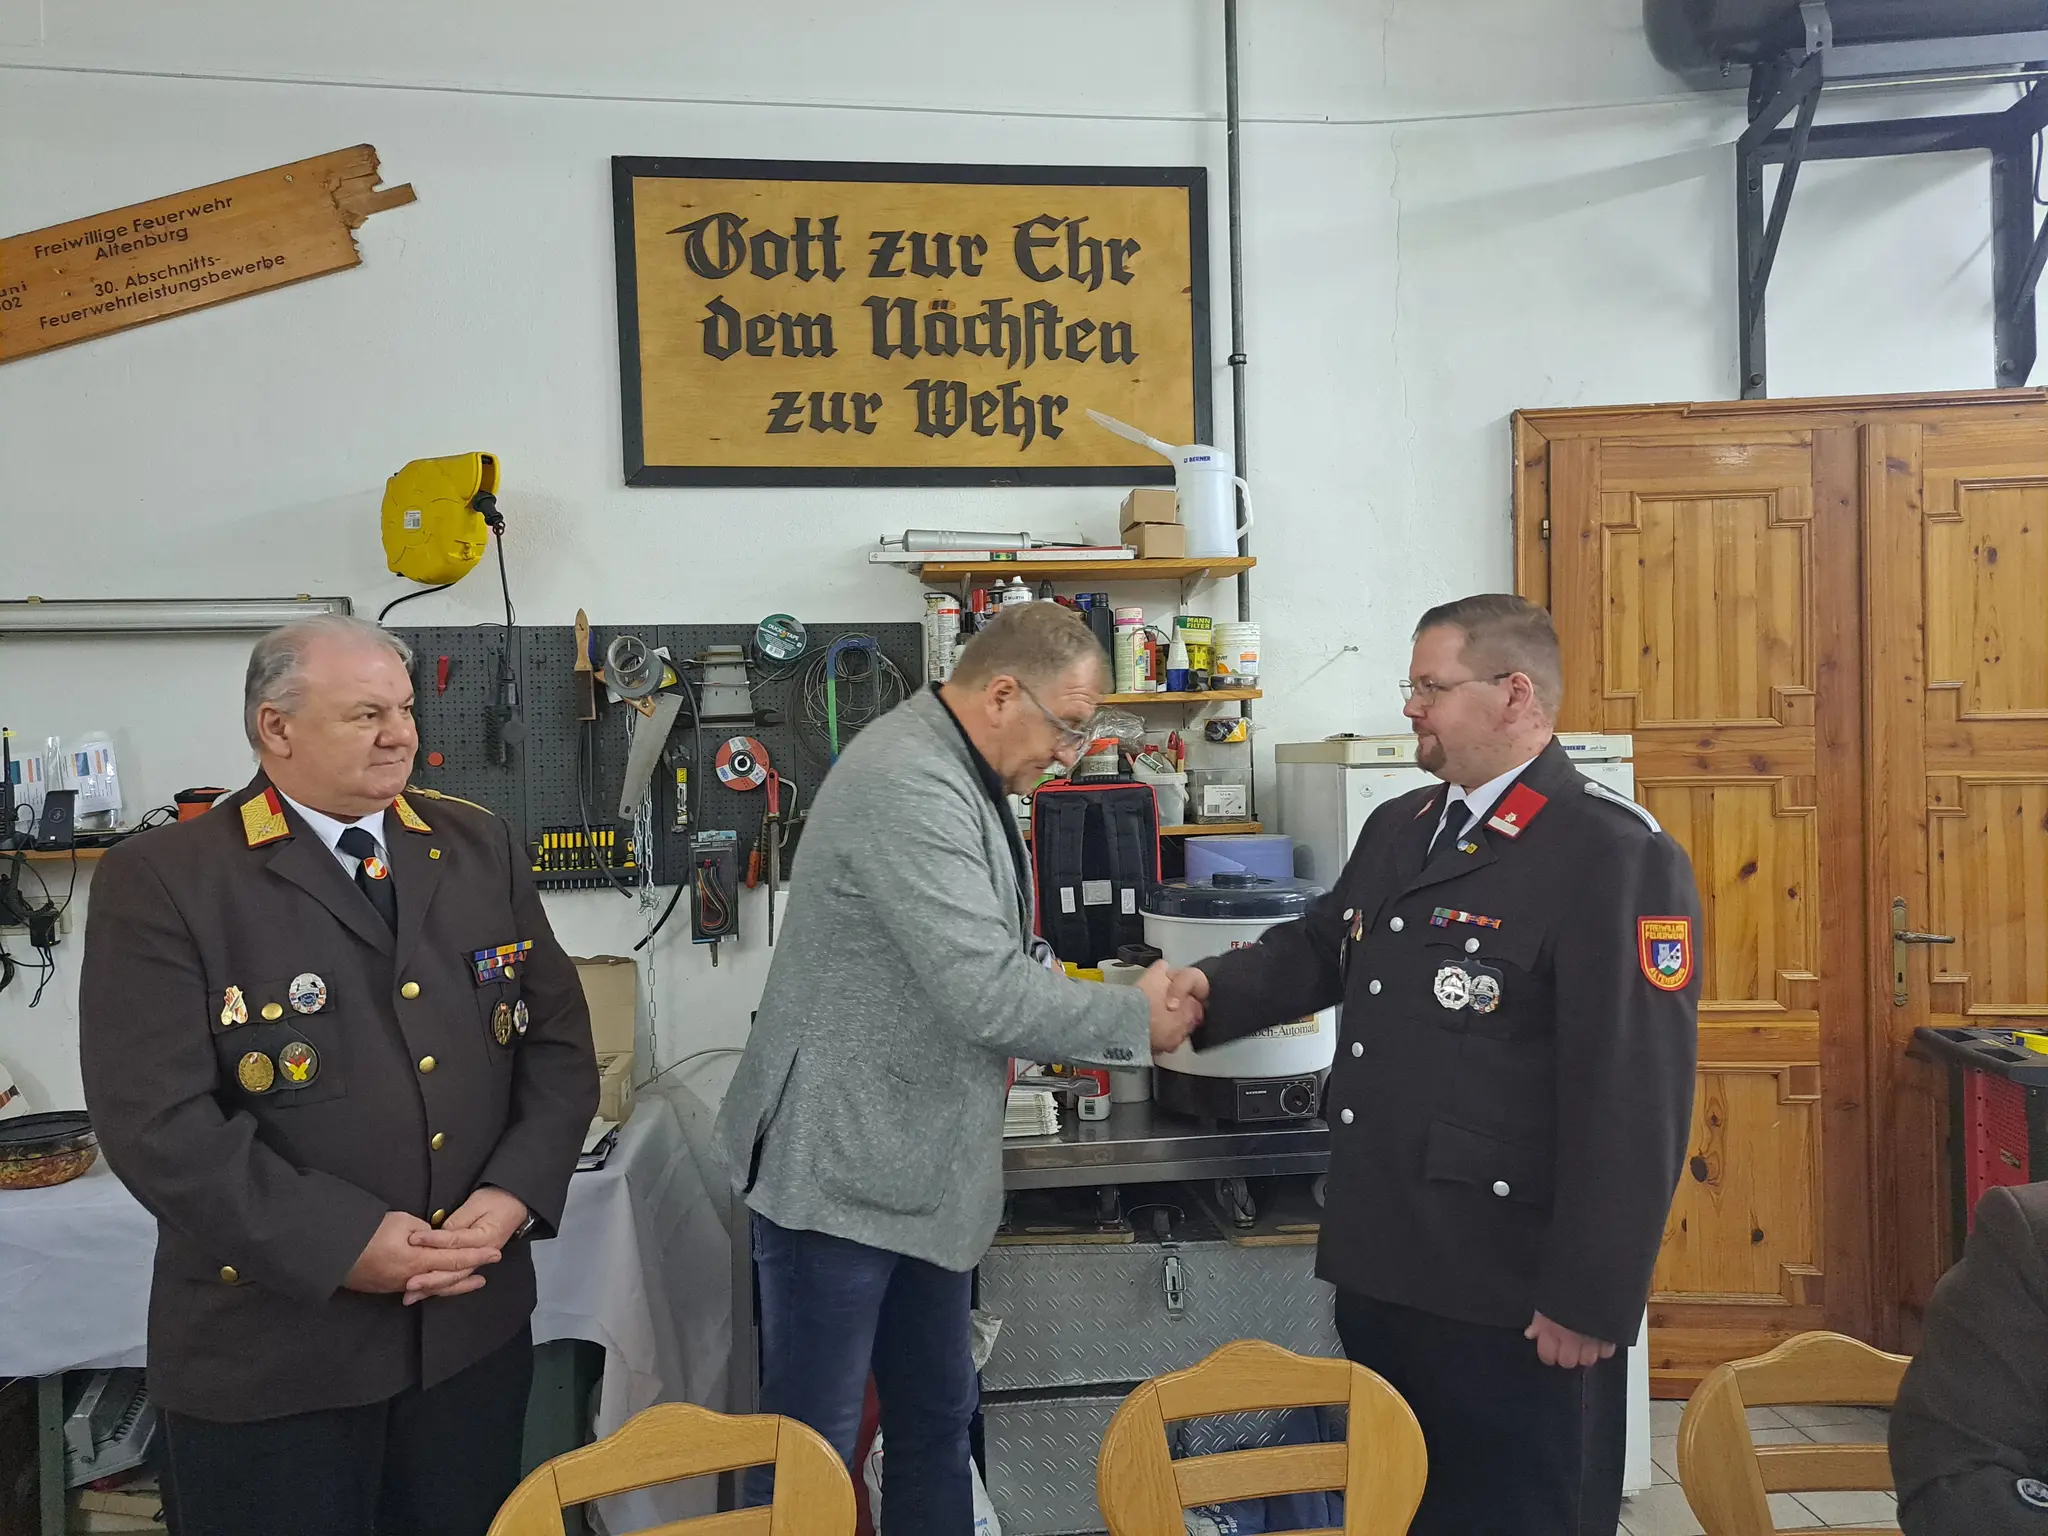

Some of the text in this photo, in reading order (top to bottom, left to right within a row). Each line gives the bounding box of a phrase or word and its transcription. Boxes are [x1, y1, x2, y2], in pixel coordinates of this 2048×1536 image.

[34, 197, 233, 259] Freiwillige Feuerwehr
[95, 226, 189, 261] Altenburg
[666, 212, 1142, 292] Gott zur Ehr
[0, 297, 23, 311] 02
[39, 253, 285, 330] Feuerwehrleistungsbewerbe
[95, 255, 221, 297] 30. Abschnitts-
[701, 295, 838, 361] dem
[766, 378, 1069, 452] zur Wehr
[786, 632, 799, 641] TAPE
